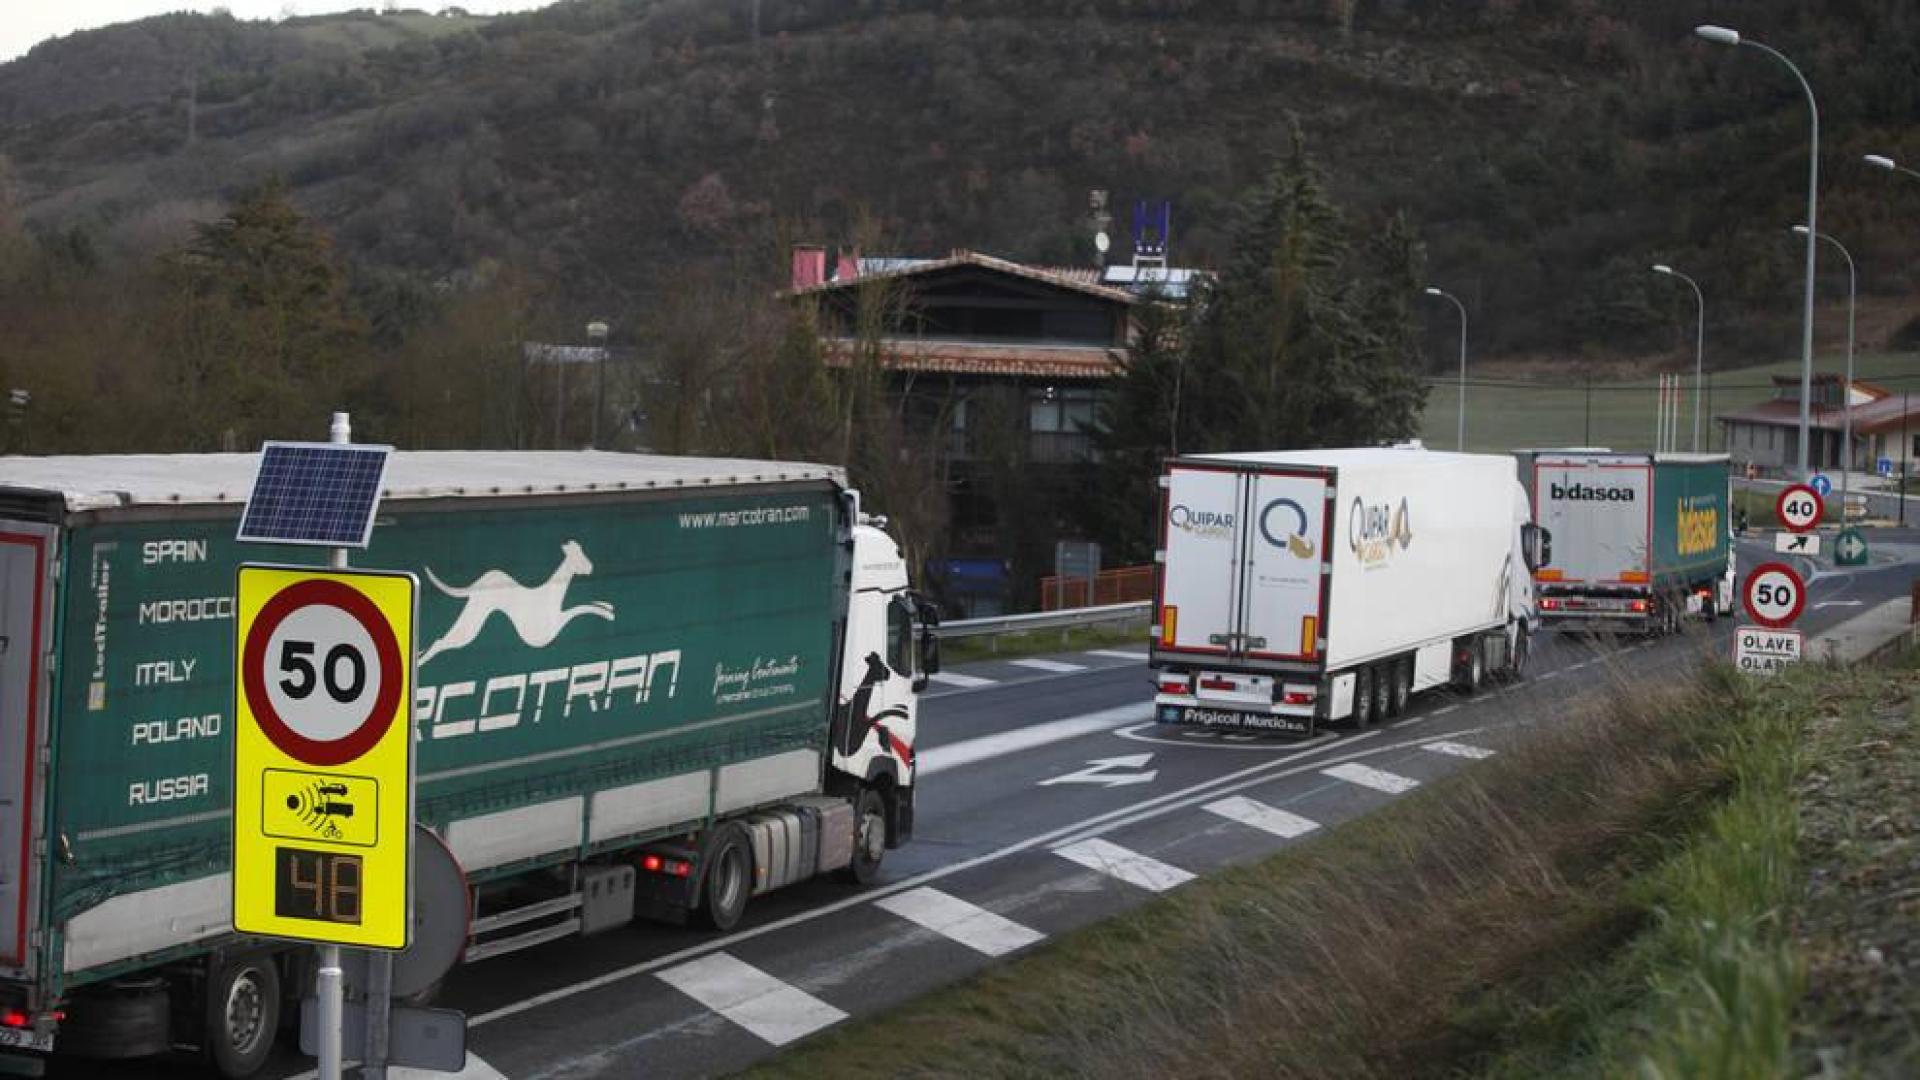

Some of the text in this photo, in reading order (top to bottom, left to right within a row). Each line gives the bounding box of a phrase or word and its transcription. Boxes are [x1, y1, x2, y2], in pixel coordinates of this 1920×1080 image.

[679, 504, 810, 528] www.marcotran.com
[1786, 501, 1814, 517] 40
[142, 540, 208, 564] SPAIN
[1757, 583, 1792, 606] 50
[139, 596, 236, 625] MOROCC
[1743, 635, 1795, 651] OLAVE
[135, 658, 197, 687] ITALY
[279, 640, 366, 703] 50
[417, 649, 682, 741] RCOTRAN
[131, 713, 222, 746] POLAND
[128, 773, 209, 806] RUSSIA
[291, 854, 360, 922] 48
